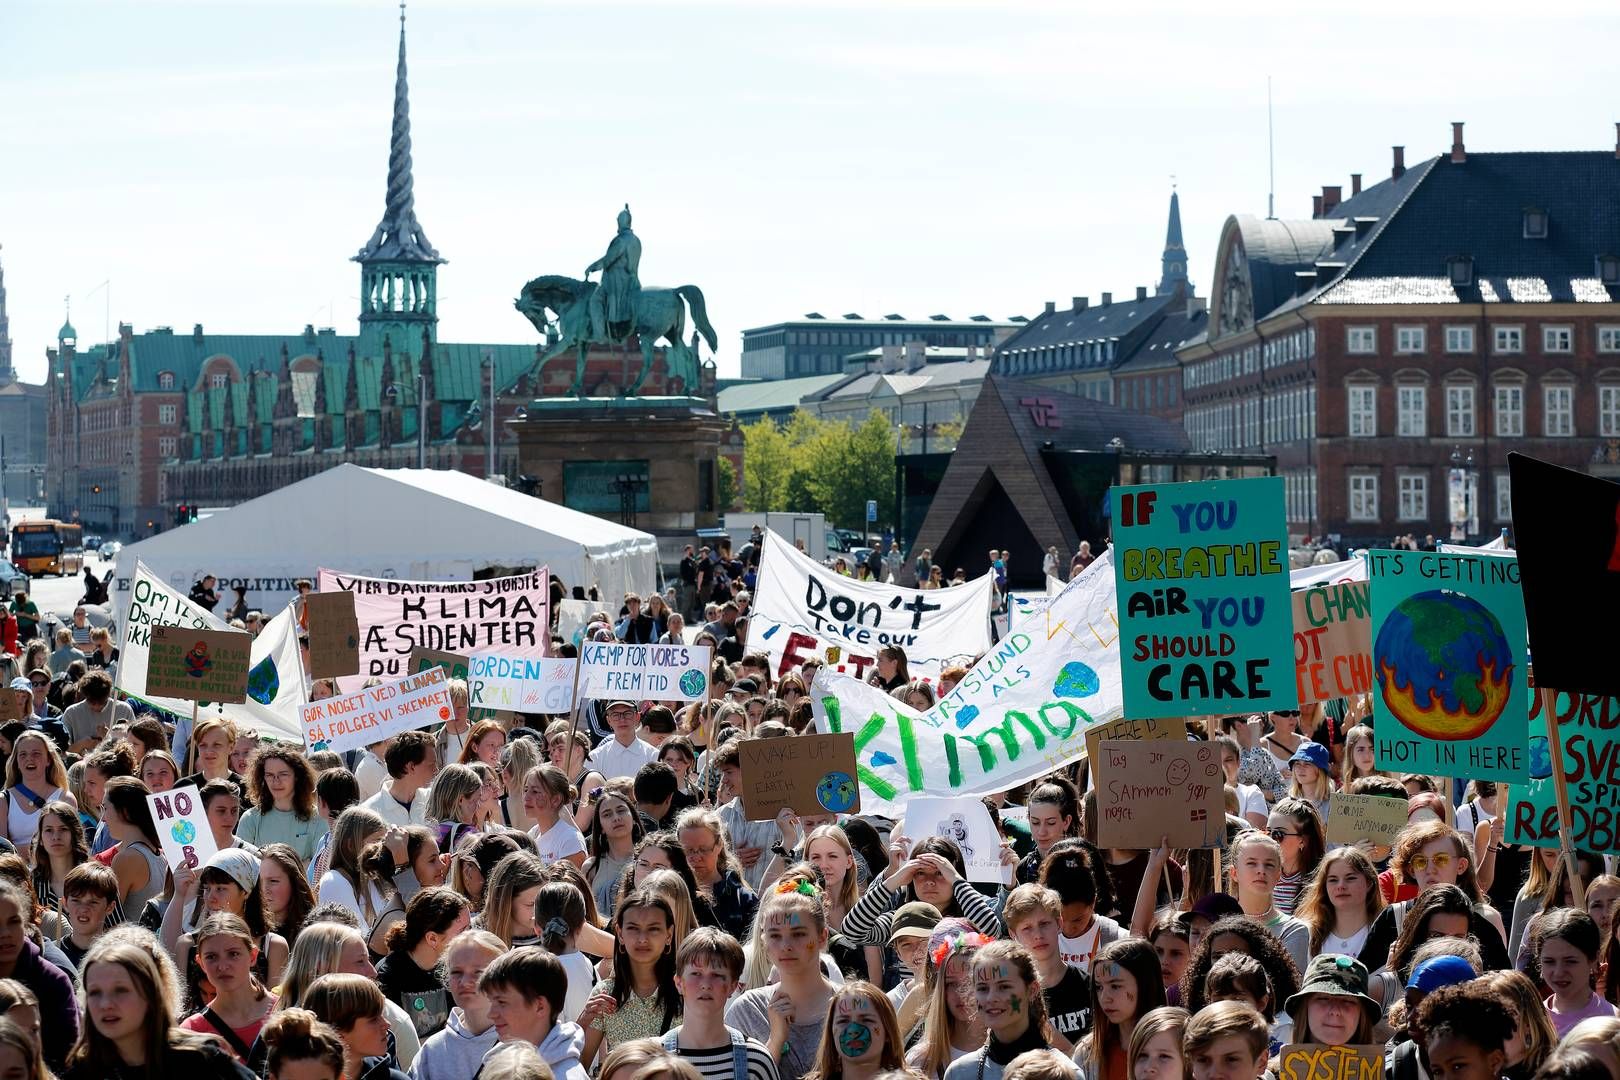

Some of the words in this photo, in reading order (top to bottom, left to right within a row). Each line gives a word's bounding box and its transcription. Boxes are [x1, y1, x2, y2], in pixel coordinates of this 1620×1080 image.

[1121, 491, 1157, 527] IF
[1171, 500, 1238, 534] YOU
[1123, 541, 1282, 581] BREATHE
[1419, 556, 1520, 584] GETTING
[402, 595, 547, 620] KLIMA-
[806, 574, 941, 630] Don't
[1192, 596, 1265, 630] YOU
[1305, 583, 1372, 627] CHAN
[127, 625, 151, 648] ikk
[364, 621, 536, 655] ÆSIDENTER
[807, 610, 871, 645] Take
[878, 632, 918, 647] our
[583, 645, 624, 666] KÆMP
[625, 646, 647, 667] FOR
[650, 648, 690, 667] VORES
[1132, 633, 1236, 661] SHOULD
[1294, 626, 1329, 666] OT
[369, 658, 400, 676] DU
[469, 656, 541, 680] JORDEN
[606, 671, 642, 691] FREM
[647, 674, 668, 691] TID
[1147, 658, 1271, 702] CARE
[303, 705, 325, 723] GØR
[327, 693, 366, 717] NOGET
[370, 685, 397, 703] VED
[308, 724, 326, 742] SÅ
[329, 712, 380, 738] FØLGER
[379, 710, 394, 722] VI
[398, 689, 450, 717] SKEMAET
[1103, 748, 1127, 769] Tag
[1380, 739, 1421, 762] HOT
[1435, 743, 1456, 764] IN
[1469, 745, 1521, 769] HERE
[1565, 734, 1620, 785] SVE
[755, 778, 797, 794] EARTH
[153, 791, 193, 821] NO
[1513, 800, 1620, 851] RØDB
[182, 845, 199, 869] B
[1280, 1045, 1383, 1080] SYSTEM
